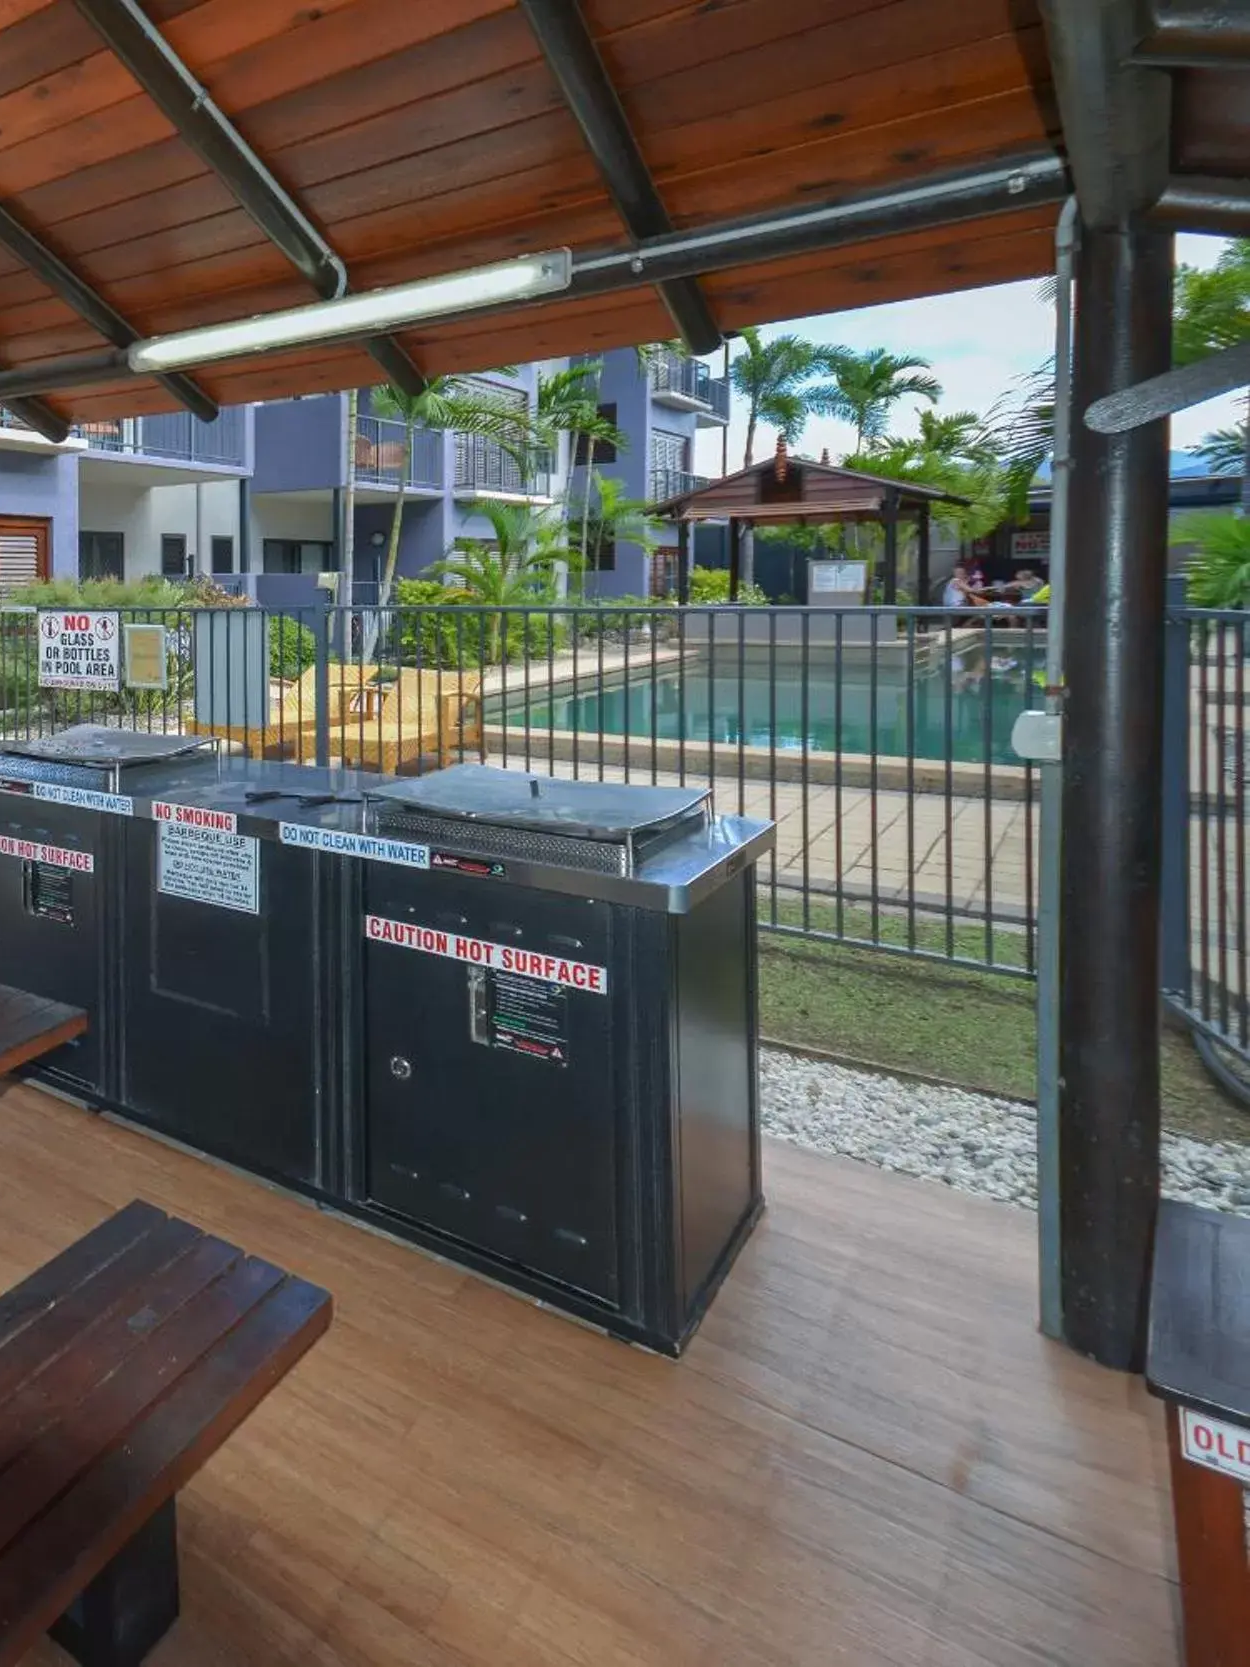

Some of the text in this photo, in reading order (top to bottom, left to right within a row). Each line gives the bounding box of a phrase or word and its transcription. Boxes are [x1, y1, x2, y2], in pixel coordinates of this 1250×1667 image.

[63, 615, 90, 631] NO
[61, 633, 94, 646] GLASS
[46, 647, 110, 661] OR BOTTLES
[42, 661, 115, 676] IN POOL AREA
[49, 785, 61, 799] NOT
[64, 788, 86, 805] CLEAN
[86, 792, 105, 808] WITH
[105, 796, 131, 811] WATER
[156, 803, 233, 831] NO SMOKING
[225, 837, 246, 848] USE
[283, 826, 427, 865] DO NOT CLEAN WITH WATER
[18, 841, 38, 858] HOT
[41, 846, 90, 870] SURFACE
[369, 918, 601, 989] CAUTION HOT SURFACE
